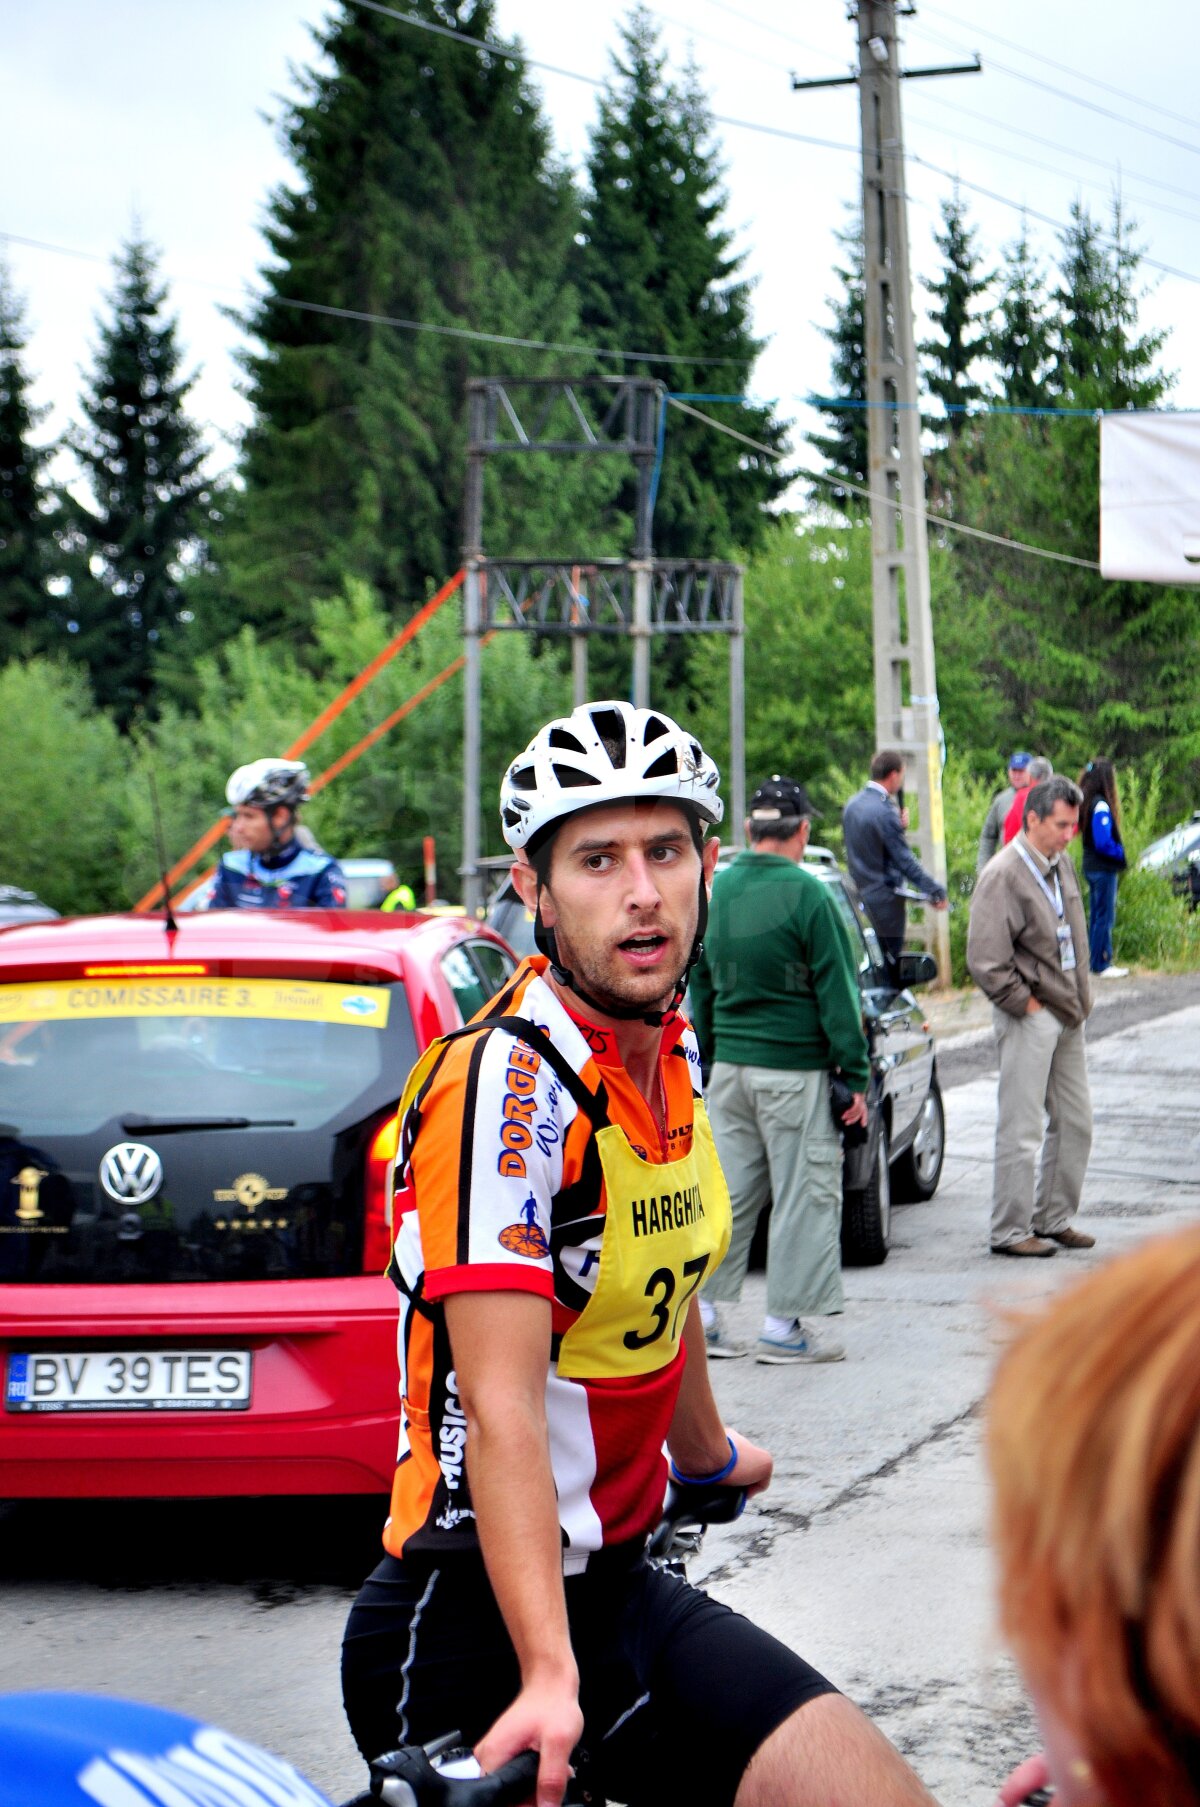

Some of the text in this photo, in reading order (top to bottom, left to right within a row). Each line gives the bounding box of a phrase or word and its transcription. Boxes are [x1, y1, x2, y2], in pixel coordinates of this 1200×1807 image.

[67, 986, 229, 1009] COMISSAIRE
[622, 1252, 711, 1351] 37
[33, 1356, 242, 1397] BV 39 TES
